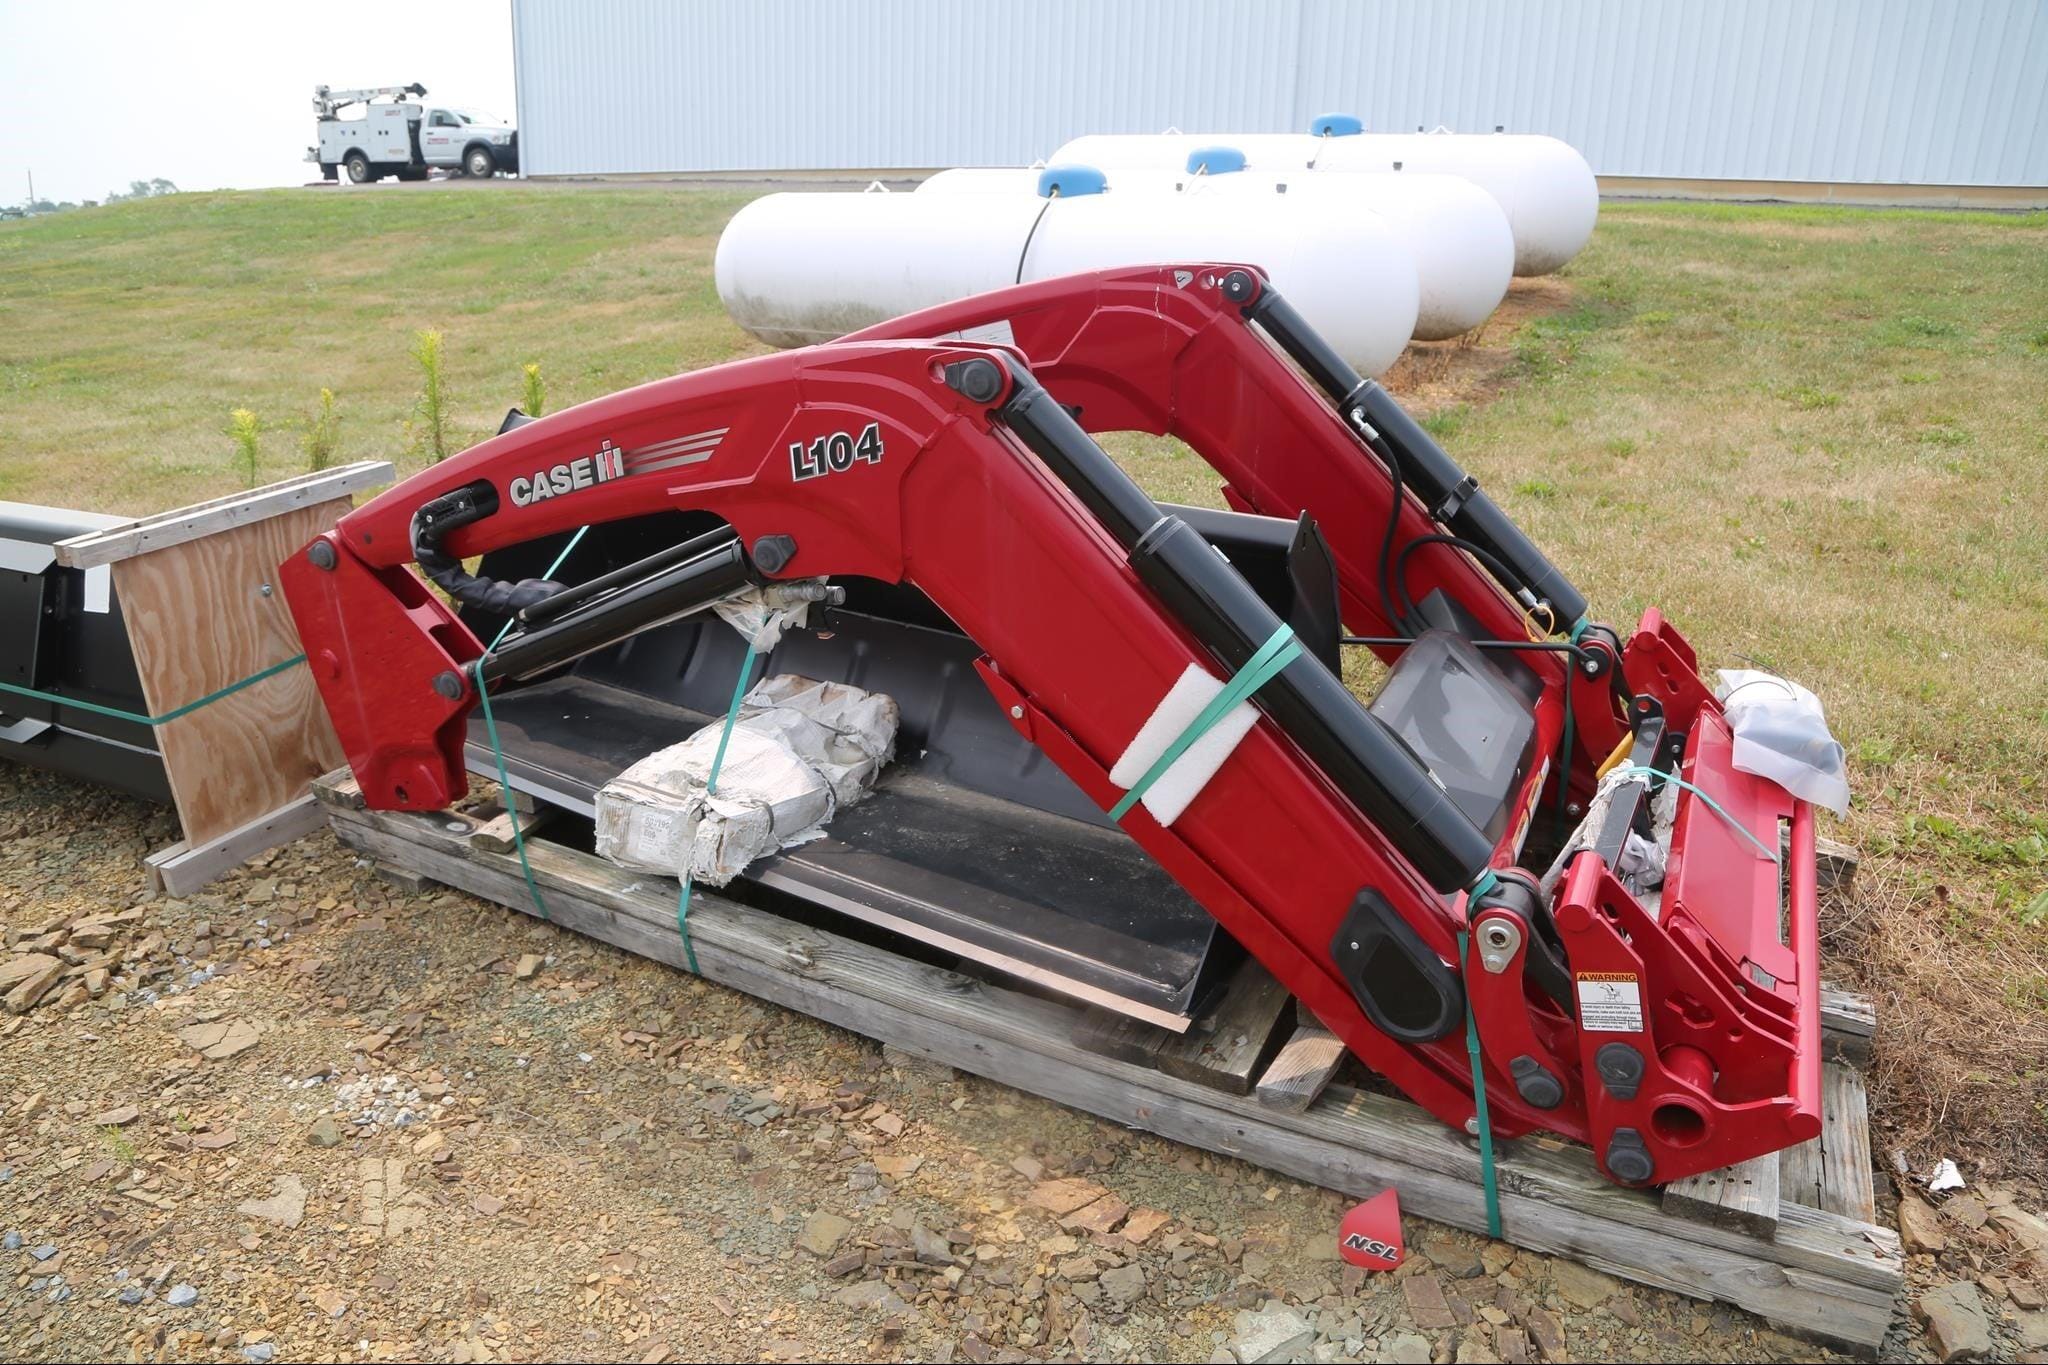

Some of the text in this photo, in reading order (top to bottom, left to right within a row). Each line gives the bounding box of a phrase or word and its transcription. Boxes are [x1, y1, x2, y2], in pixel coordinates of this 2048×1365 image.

[789, 422, 884, 482] L104
[509, 457, 594, 507] CASE
[1343, 1232, 1398, 1262] NSL
